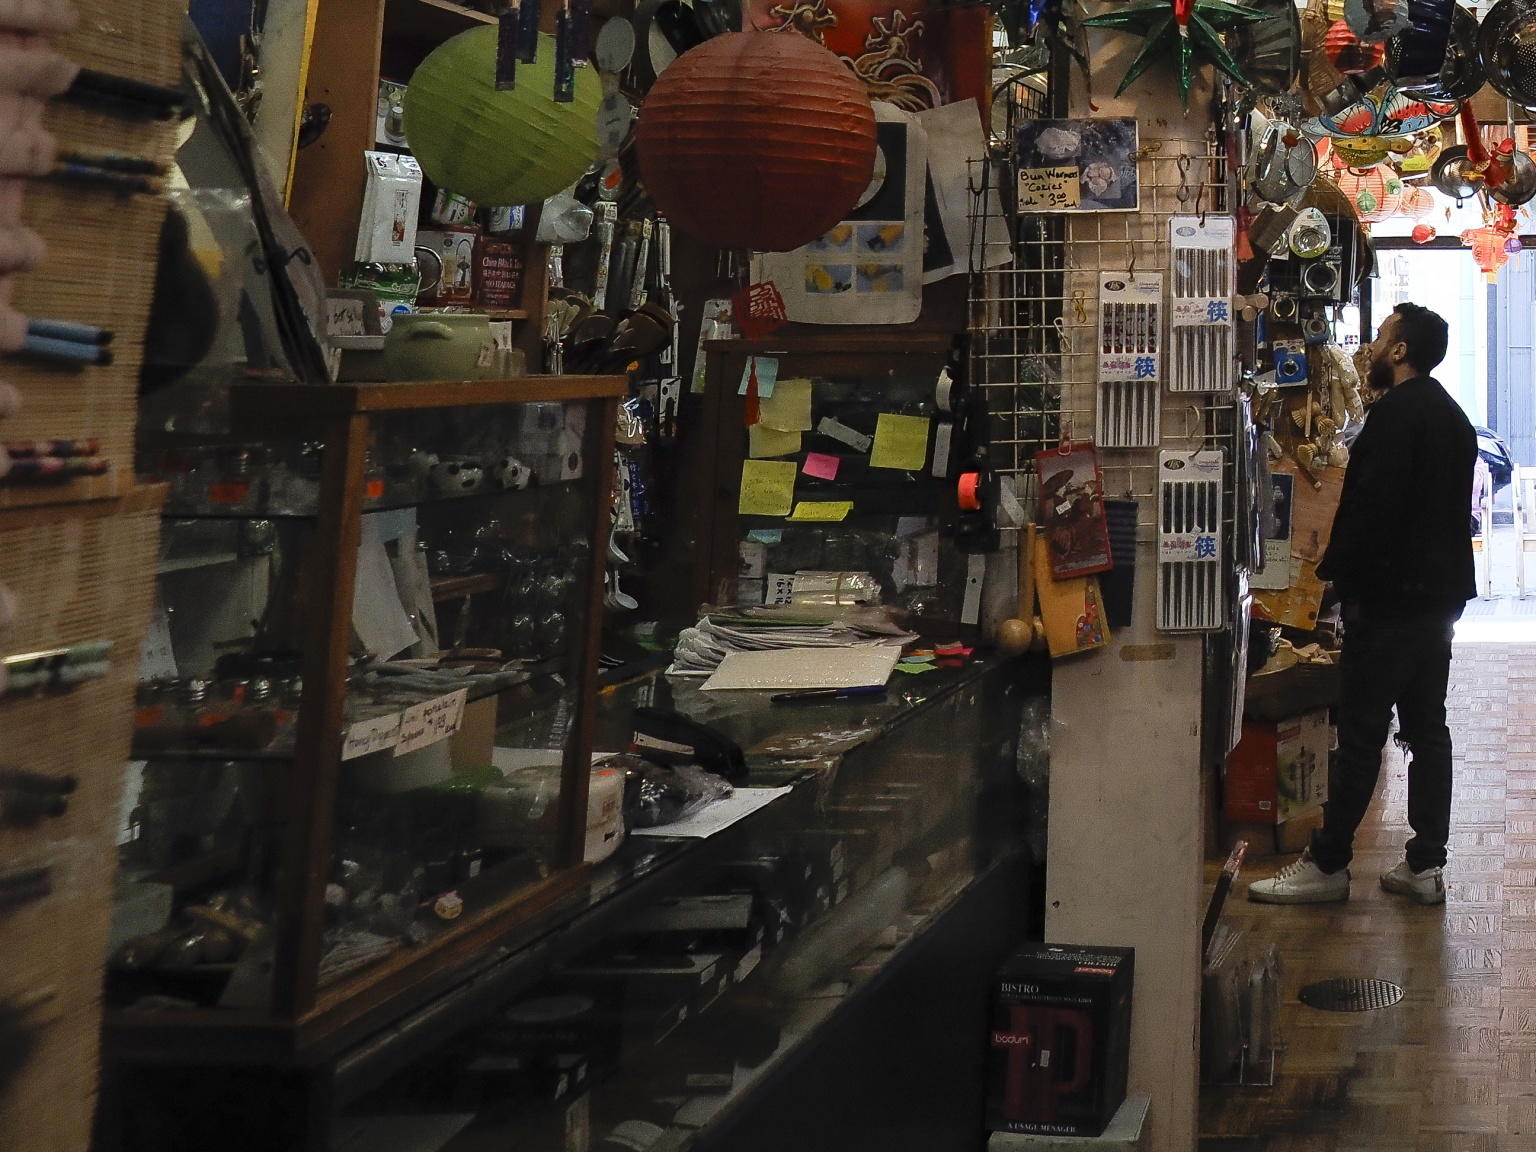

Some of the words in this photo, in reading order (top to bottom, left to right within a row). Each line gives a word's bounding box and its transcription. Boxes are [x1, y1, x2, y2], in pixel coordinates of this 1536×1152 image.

[1020, 170, 1044, 181] Bun
[1206, 300, 1228, 323] 筷
[1134, 356, 1156, 379] 筷
[1194, 535, 1217, 559] 筷
[1001, 982, 1039, 994] BISTRO
